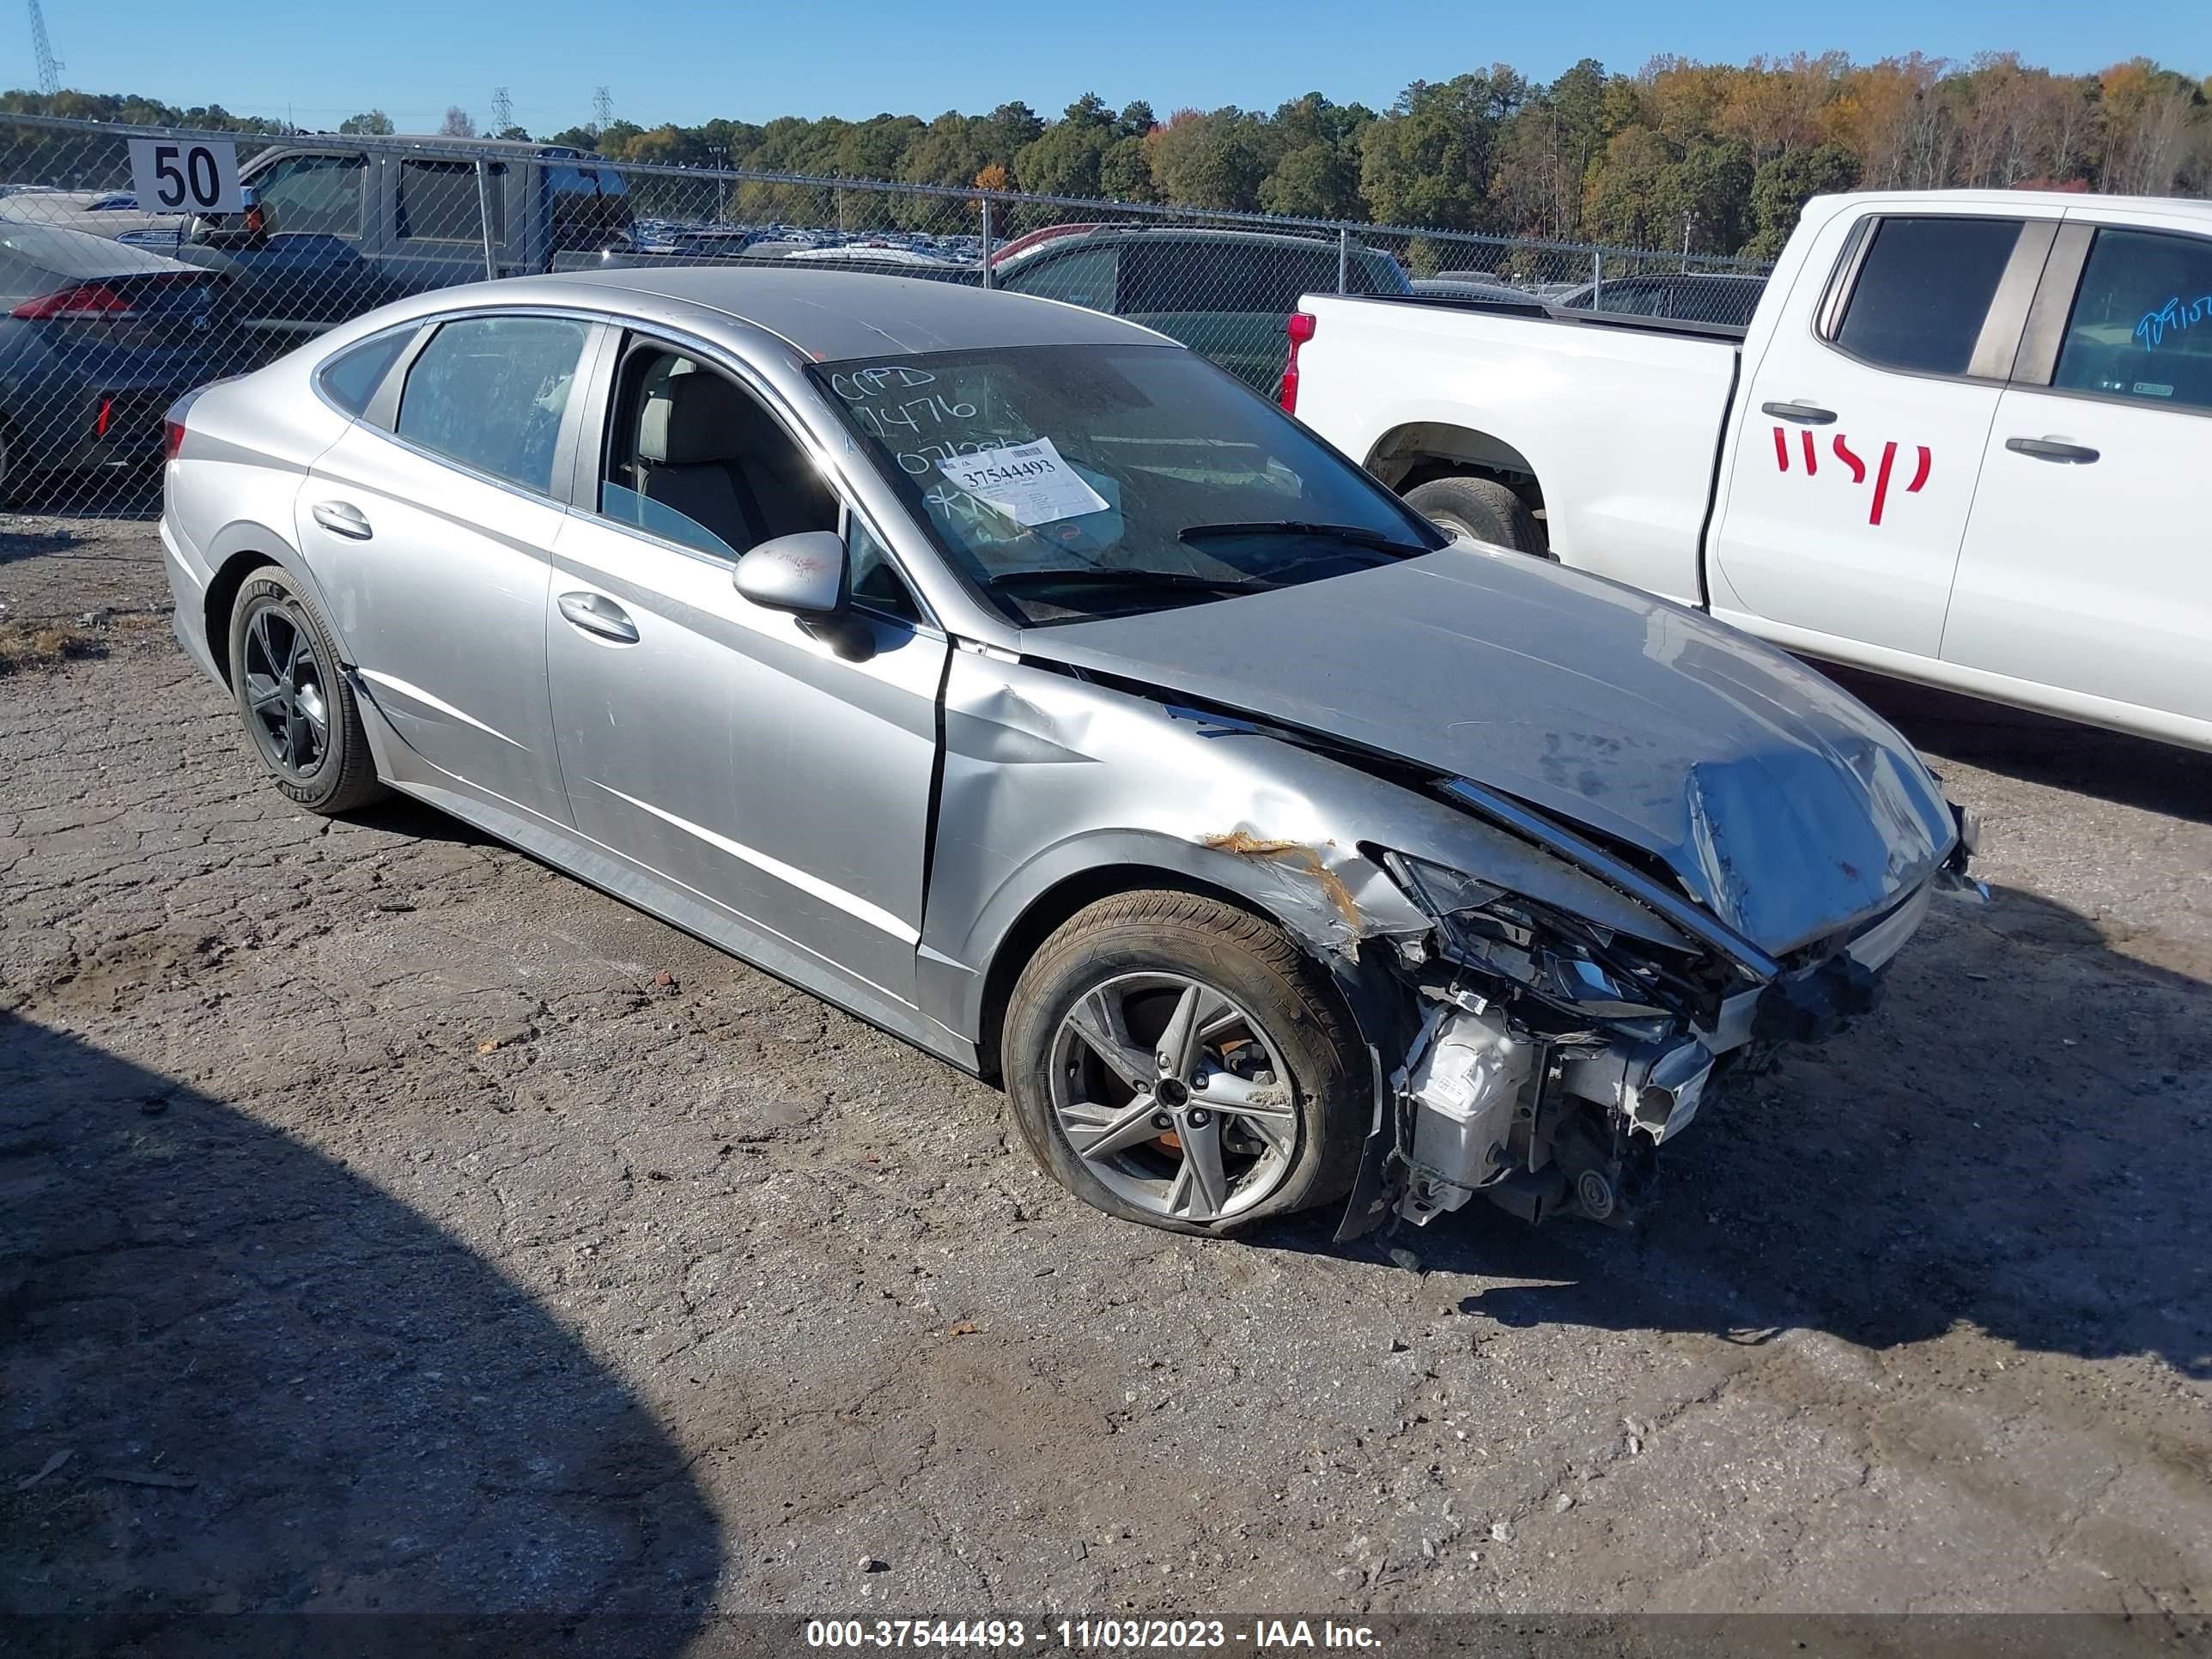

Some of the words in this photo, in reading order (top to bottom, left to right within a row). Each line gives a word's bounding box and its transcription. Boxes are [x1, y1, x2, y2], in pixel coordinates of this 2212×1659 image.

[155, 145, 221, 208] 50
[866, 394, 977, 439] 1476
[962, 459, 1056, 489] 37544493
